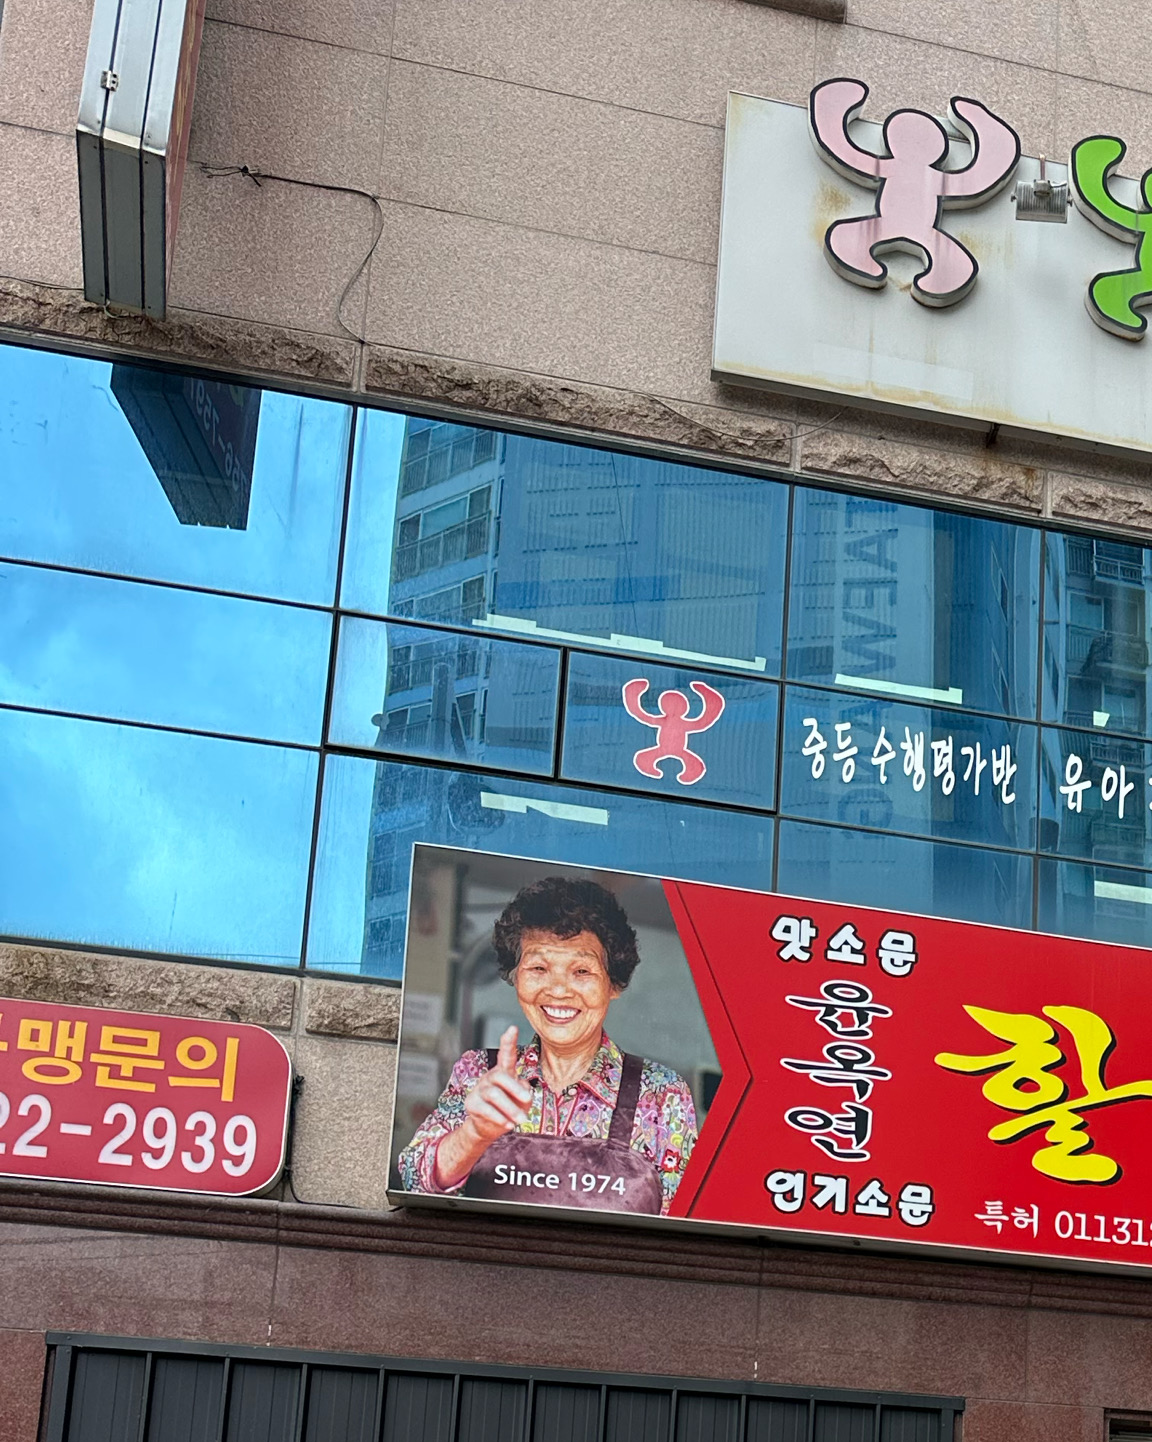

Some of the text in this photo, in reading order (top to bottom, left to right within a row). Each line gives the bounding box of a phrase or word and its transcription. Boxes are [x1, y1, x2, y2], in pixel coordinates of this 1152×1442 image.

[1059, 753, 1136, 819] 유아
[771, 916, 918, 977] 맛소문
[0, 1012, 240, 1103] 맹문의
[780, 978, 894, 1163] 윤옥연
[0, 1092, 258, 1178] 2-2939
[494, 1163, 627, 1196] Since 1974
[766, 1169, 935, 1227] 인기소문
[974, 1200, 1039, 1238] 특허
